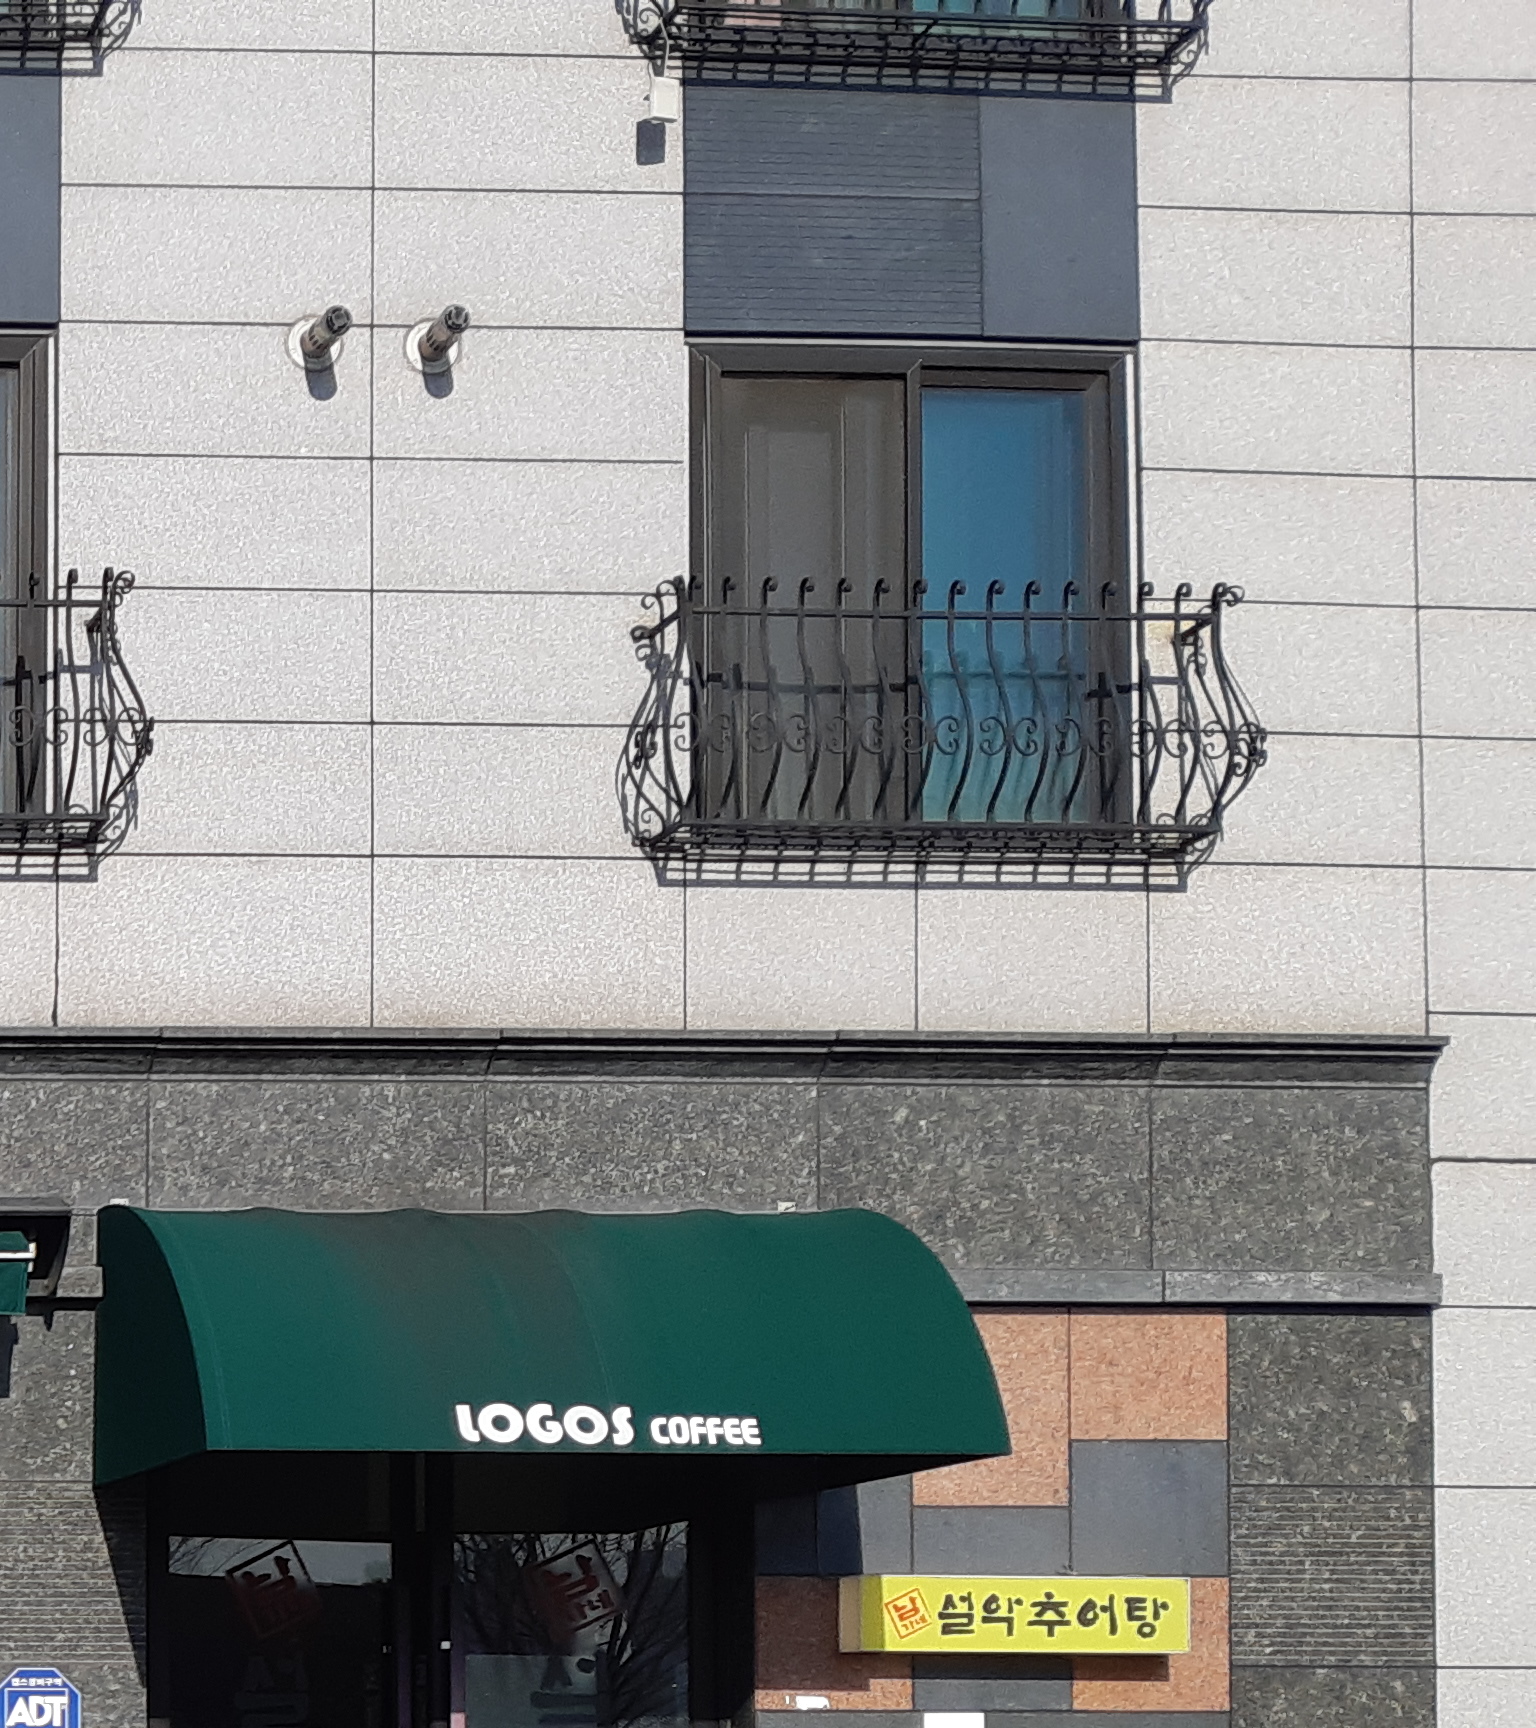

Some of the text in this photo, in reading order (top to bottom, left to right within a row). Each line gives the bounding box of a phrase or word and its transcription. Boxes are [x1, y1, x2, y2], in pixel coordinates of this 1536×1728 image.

[455, 1402, 762, 1447] LOGOS COFFEE
[937, 1591, 1170, 1639] 설악추어탕
[6, 1695, 68, 1728] ADT
